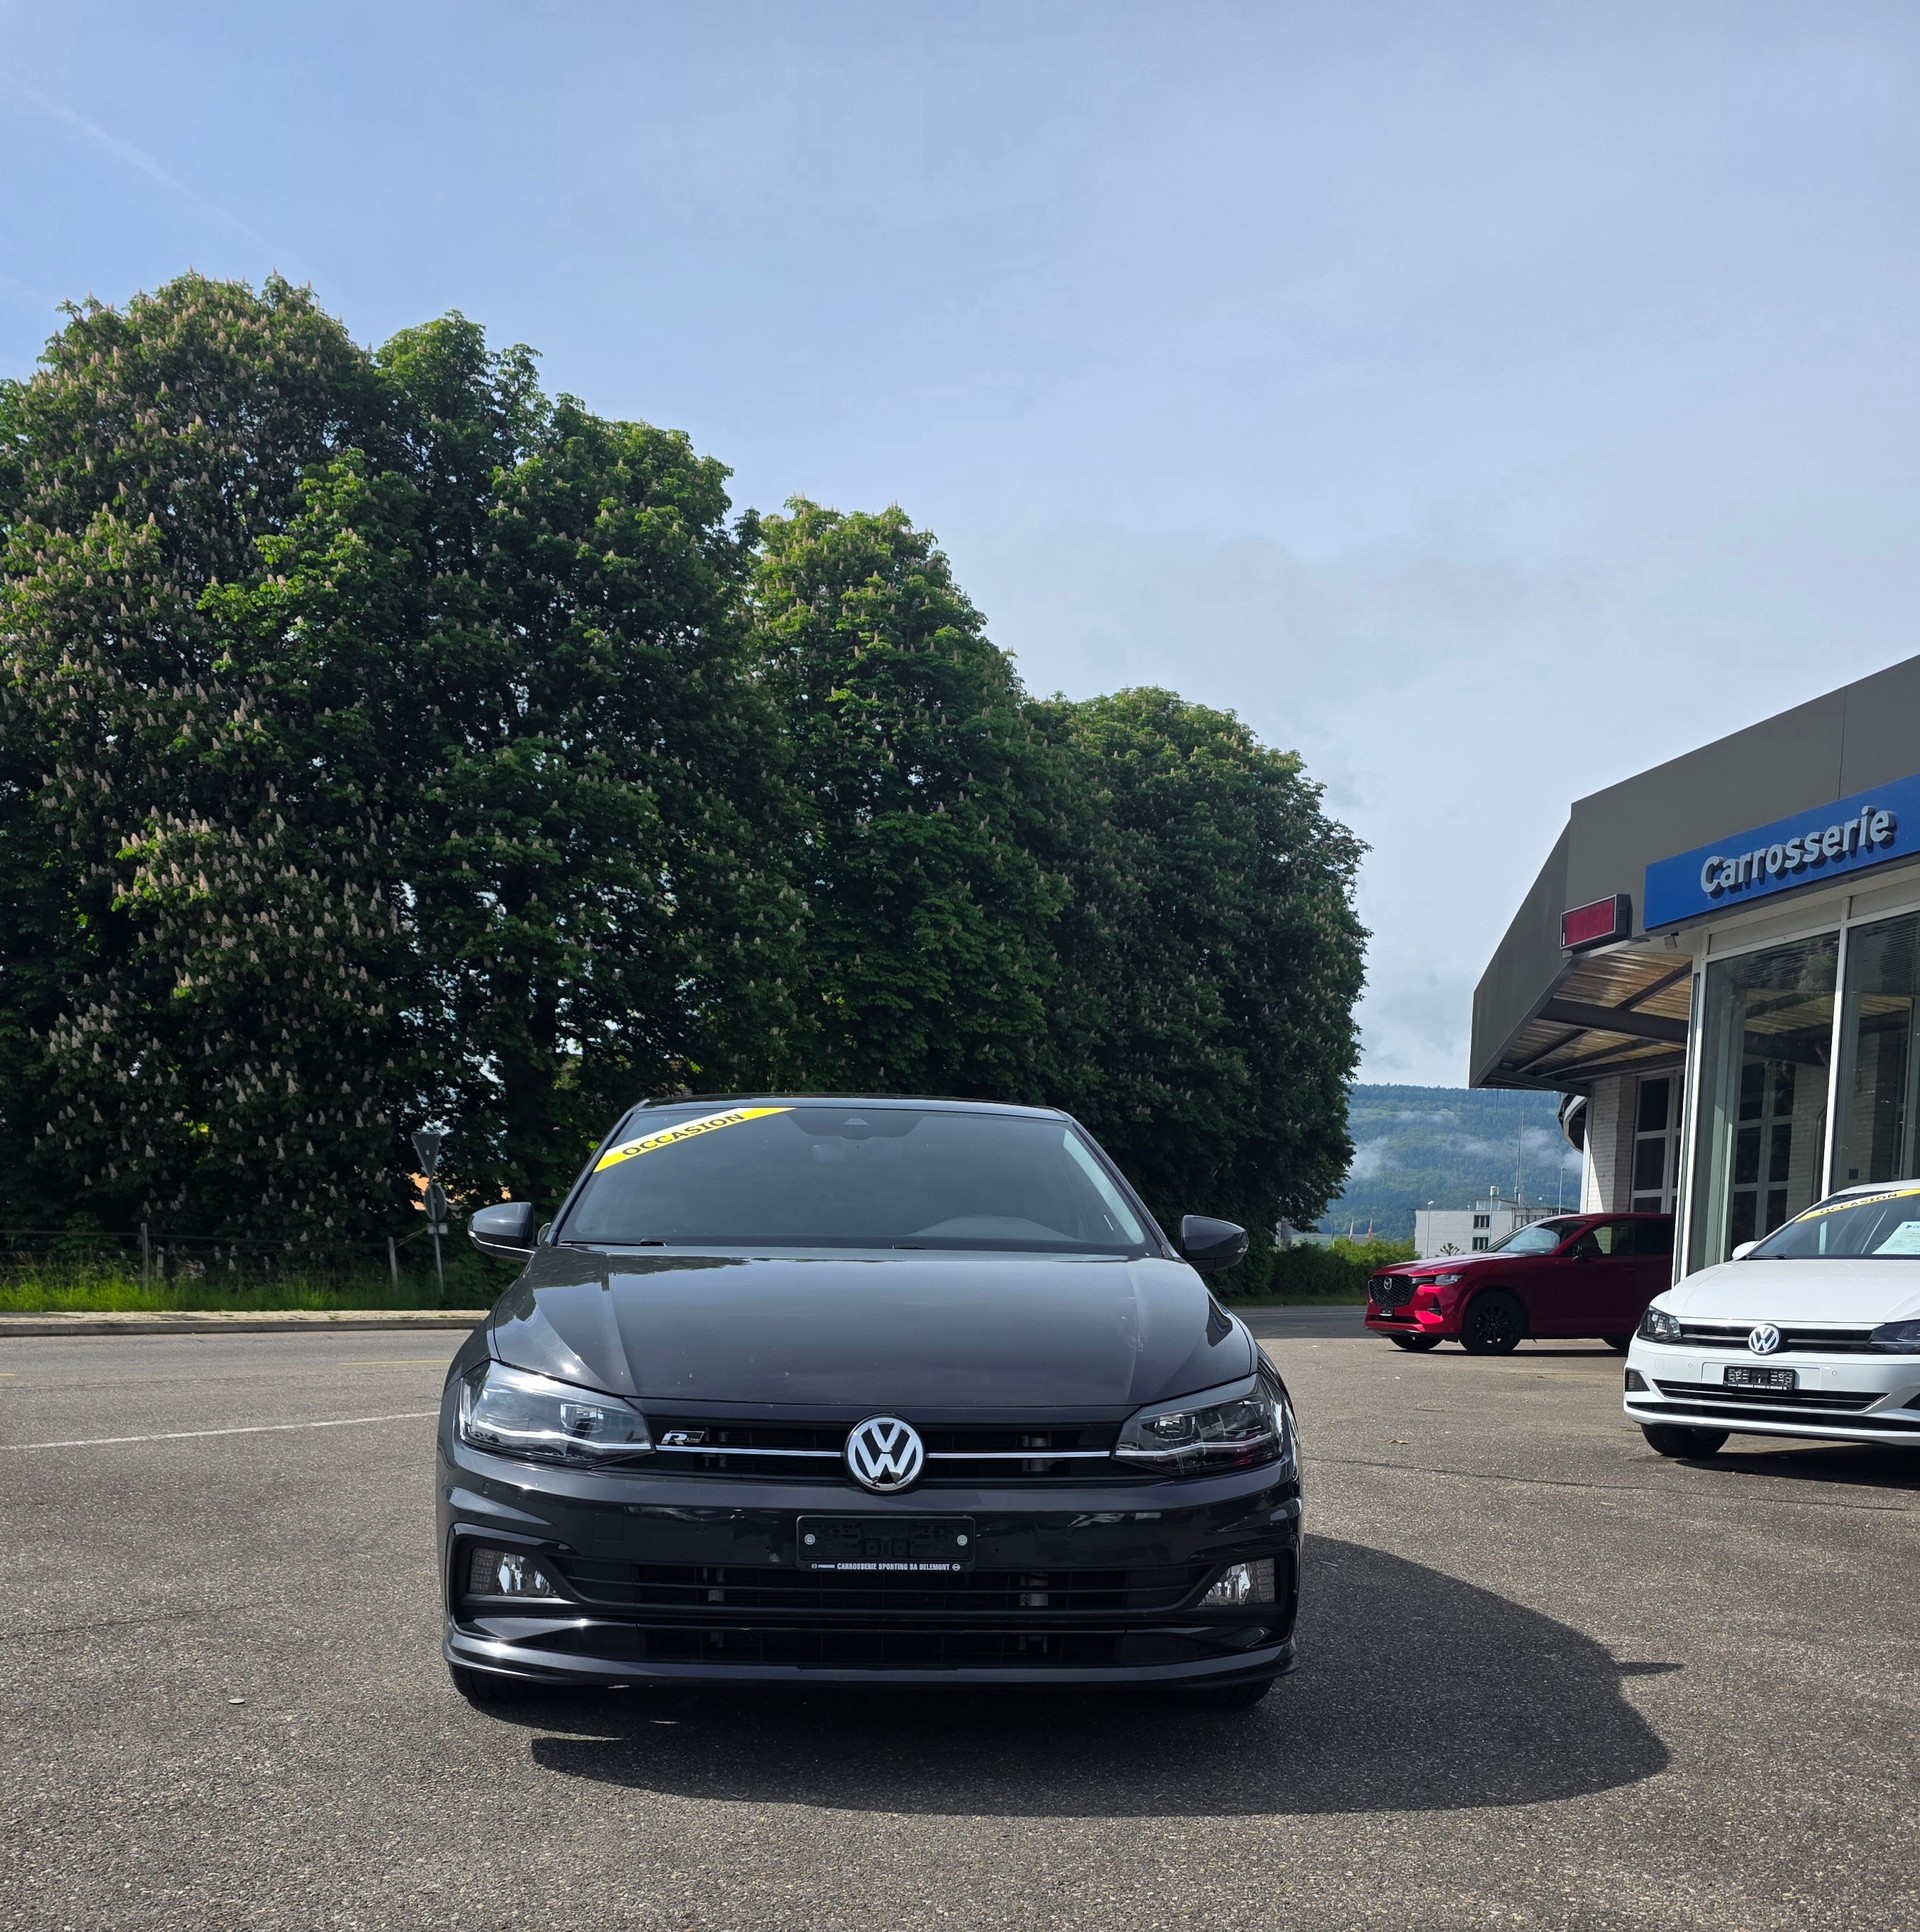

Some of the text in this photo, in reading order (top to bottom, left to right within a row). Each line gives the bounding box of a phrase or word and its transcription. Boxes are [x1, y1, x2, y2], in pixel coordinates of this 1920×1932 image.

[1701, 805, 1895, 893] Carrosserie
[621, 1113, 746, 1156] OCCASION
[1819, 1193, 1898, 1215] OCCASION
[847, 1417, 924, 1491] VW
[836, 1562, 877, 1571] CARROSSERIE
[878, 1562, 908, 1571] SPORTING
[909, 1563, 918, 1571] SA
[919, 1563, 950, 1571] DELEMONT
